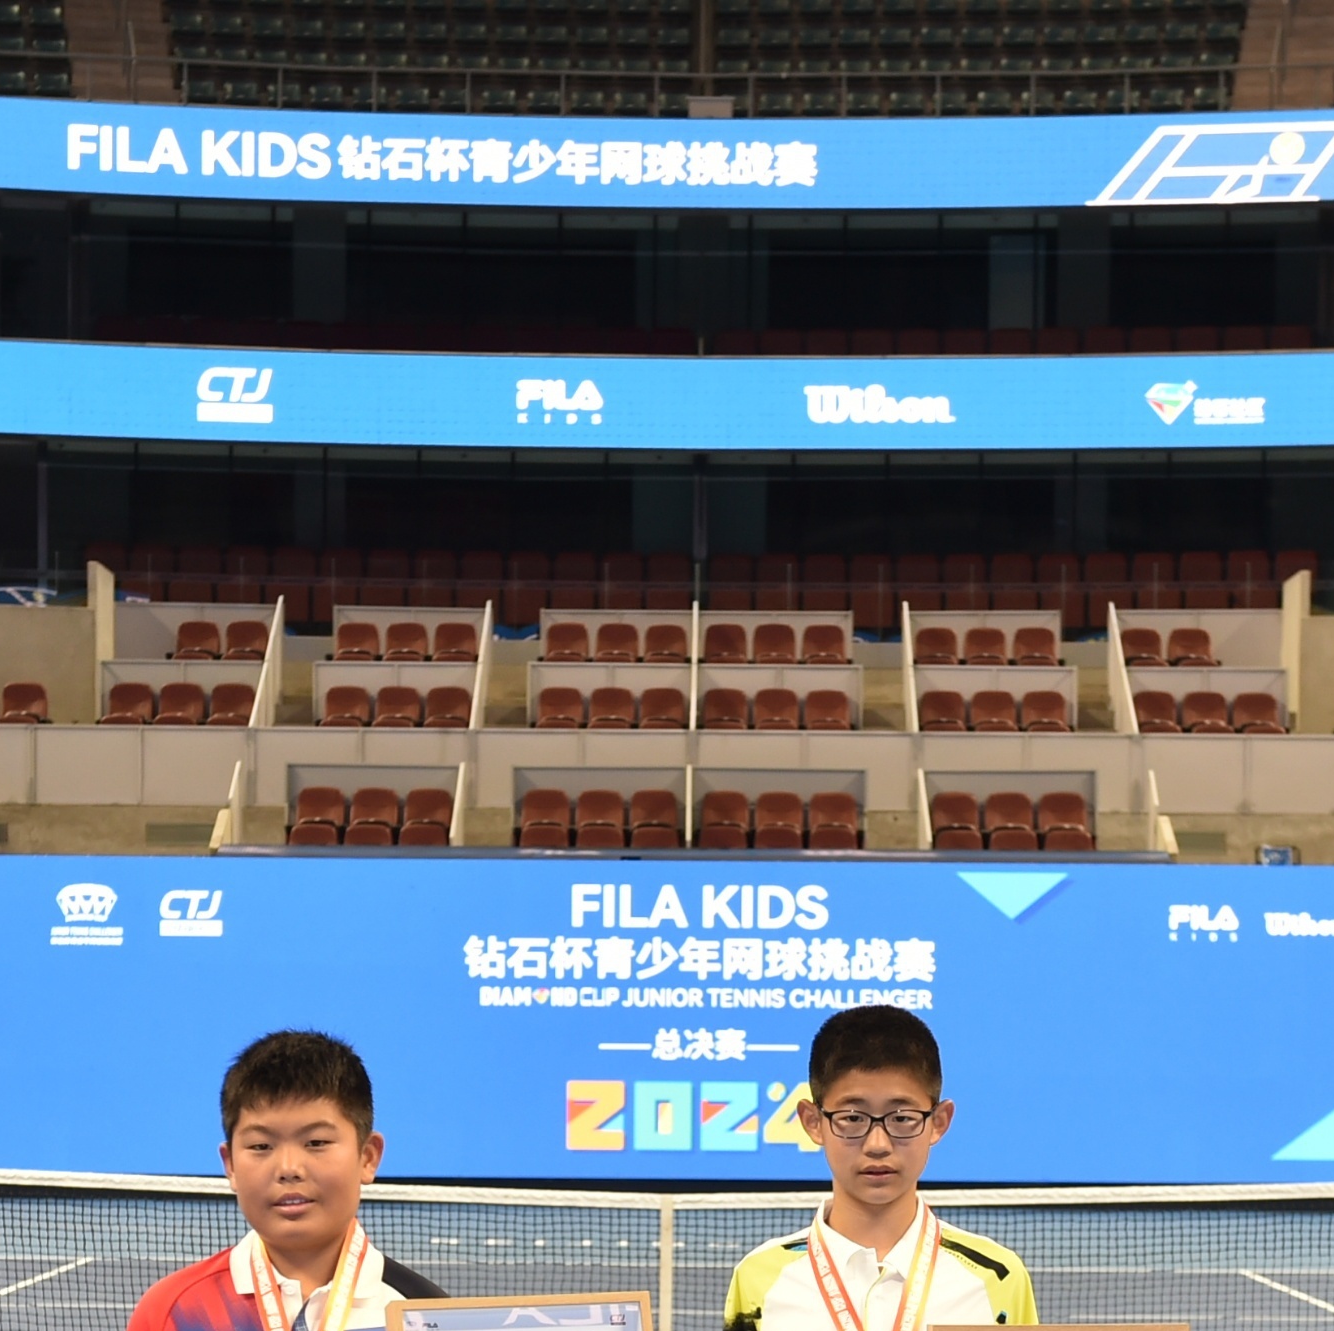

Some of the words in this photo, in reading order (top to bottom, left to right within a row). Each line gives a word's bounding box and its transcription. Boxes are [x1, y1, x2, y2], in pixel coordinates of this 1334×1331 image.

[68, 124, 188, 174] FILA
[202, 130, 331, 179] KIDS
[337, 135, 818, 186] 钻石杯青少年网球挑战赛
[197, 367, 273, 403] CTJ
[516, 379, 604, 411] FILA
[804, 384, 956, 423] Wilson
[160, 890, 222, 919] CTJ
[572, 884, 688, 928] FILA
[702, 885, 829, 930] KIDS
[1169, 905, 1239, 931] FILA
[464, 935, 936, 982] 钻石杯青少年网球挑战赛
[622, 988, 703, 1007] JUNIOR
[707, 988, 785, 1008] TENNIS
[789, 989, 932, 1010] CHALLENGER
